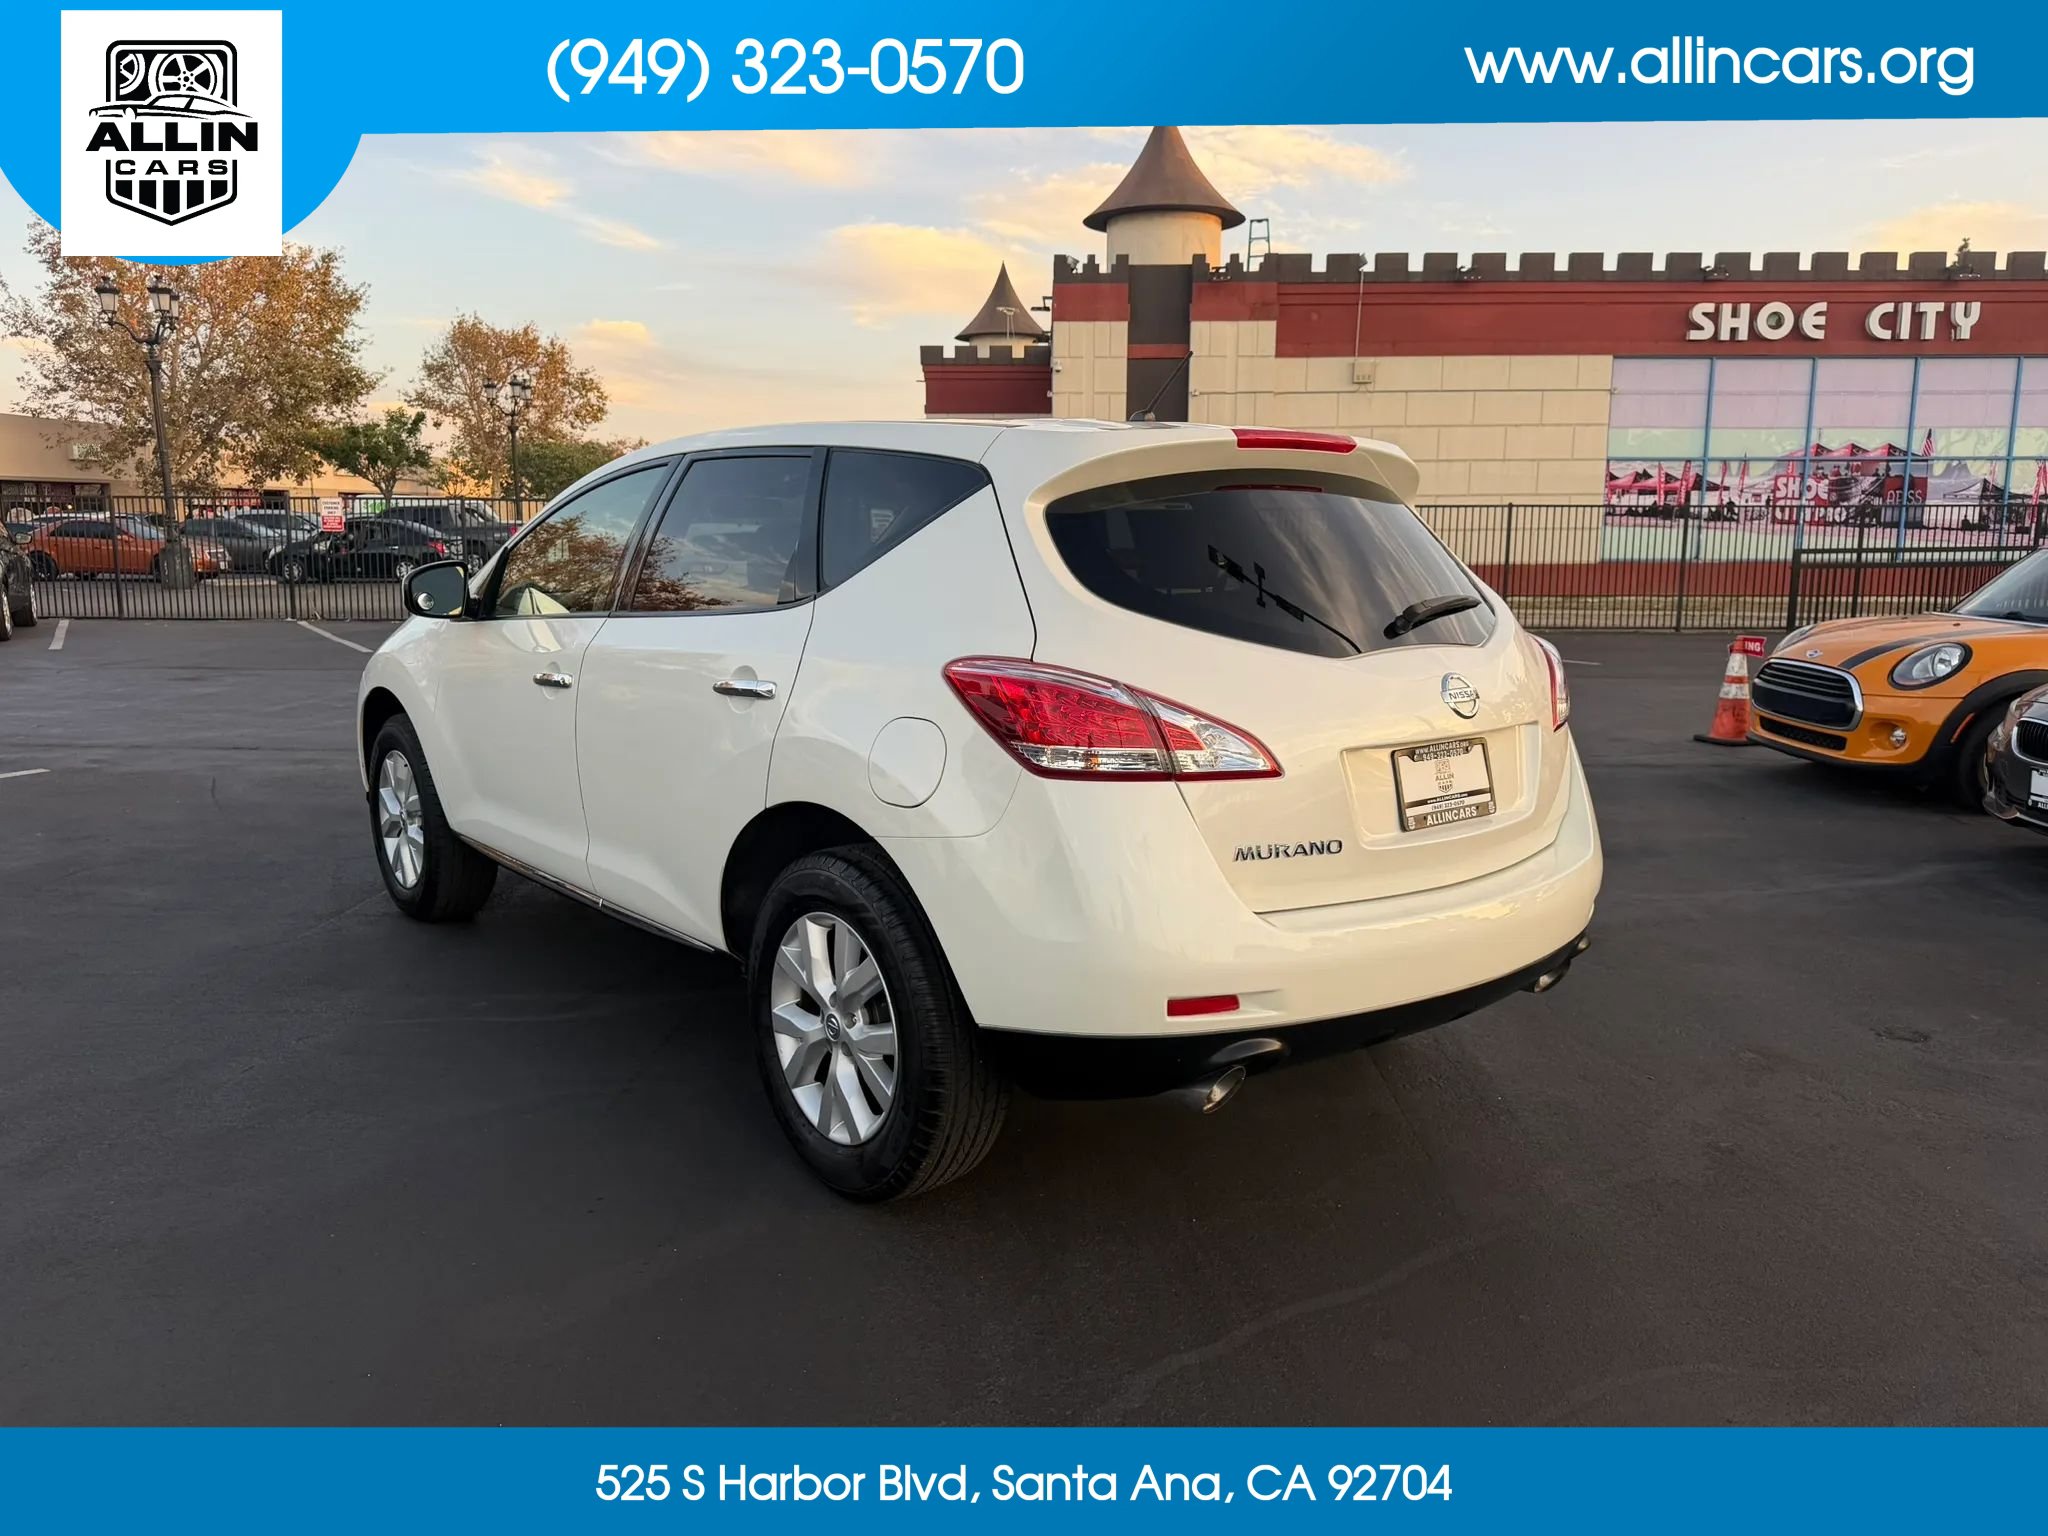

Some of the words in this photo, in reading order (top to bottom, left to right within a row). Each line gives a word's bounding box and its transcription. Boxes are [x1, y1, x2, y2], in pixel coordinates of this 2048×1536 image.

[1686, 301, 1828, 341] SHOE
[1865, 301, 1982, 341] CITY
[1775, 477, 1829, 500] SHOE
[1426, 806, 1477, 826] ALLINCARS
[1233, 839, 1343, 862] MURANO
